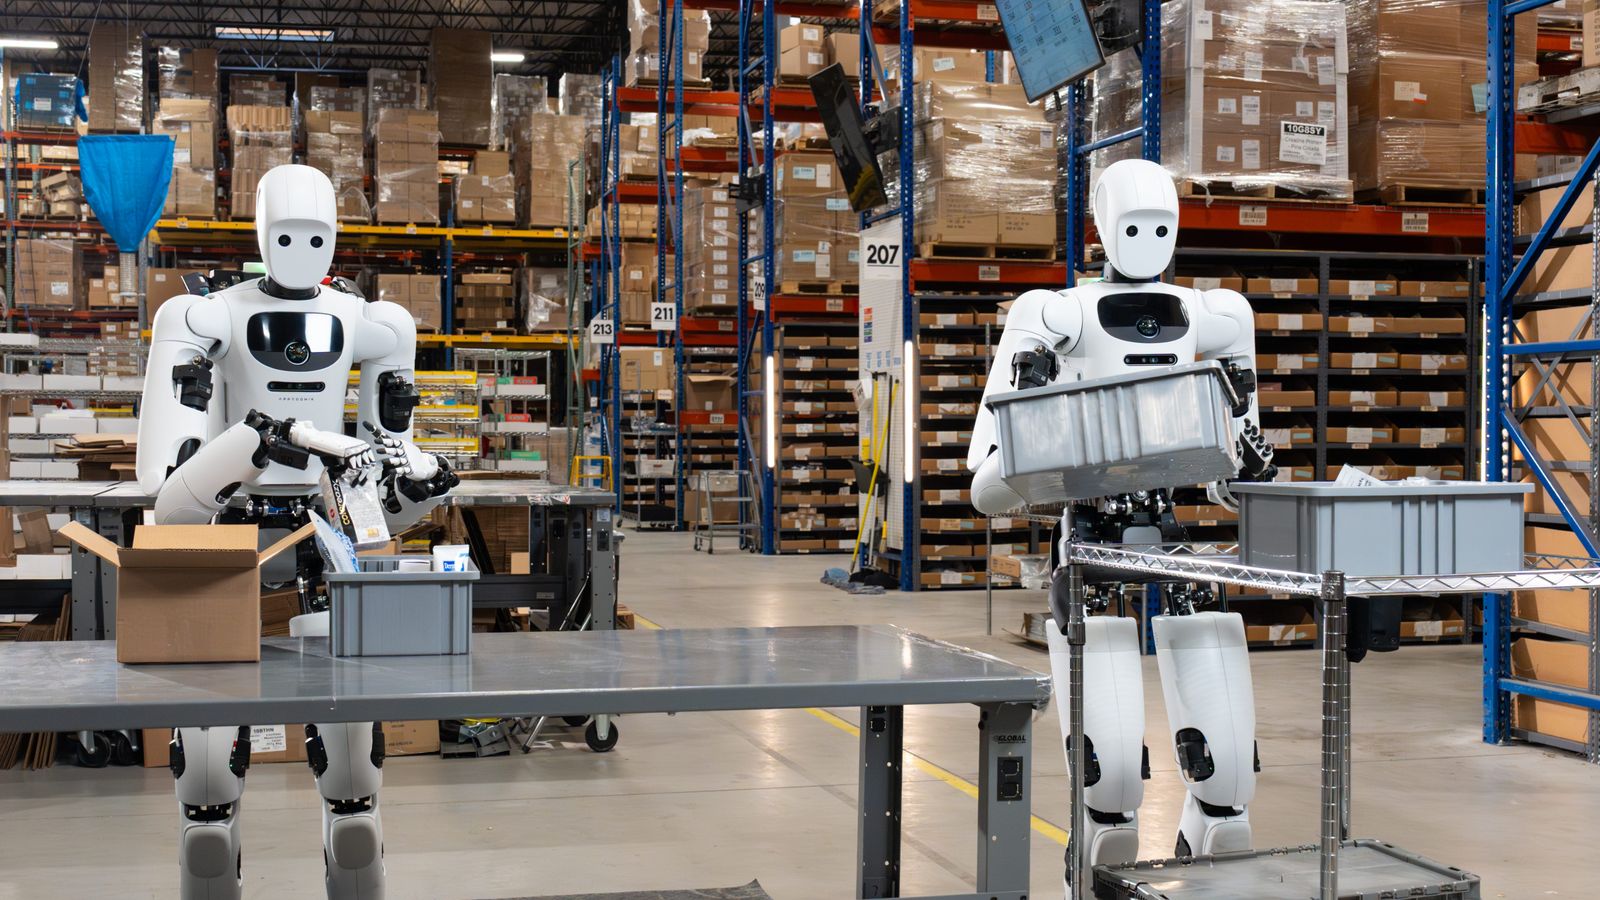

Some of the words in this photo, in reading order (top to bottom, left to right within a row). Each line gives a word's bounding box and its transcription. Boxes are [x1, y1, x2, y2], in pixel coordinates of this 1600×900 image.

[1287, 124, 1321, 135] 10G8SY
[867, 244, 900, 264] 207
[755, 281, 765, 298] 209
[654, 307, 673, 320] 211
[593, 324, 612, 335] 213
